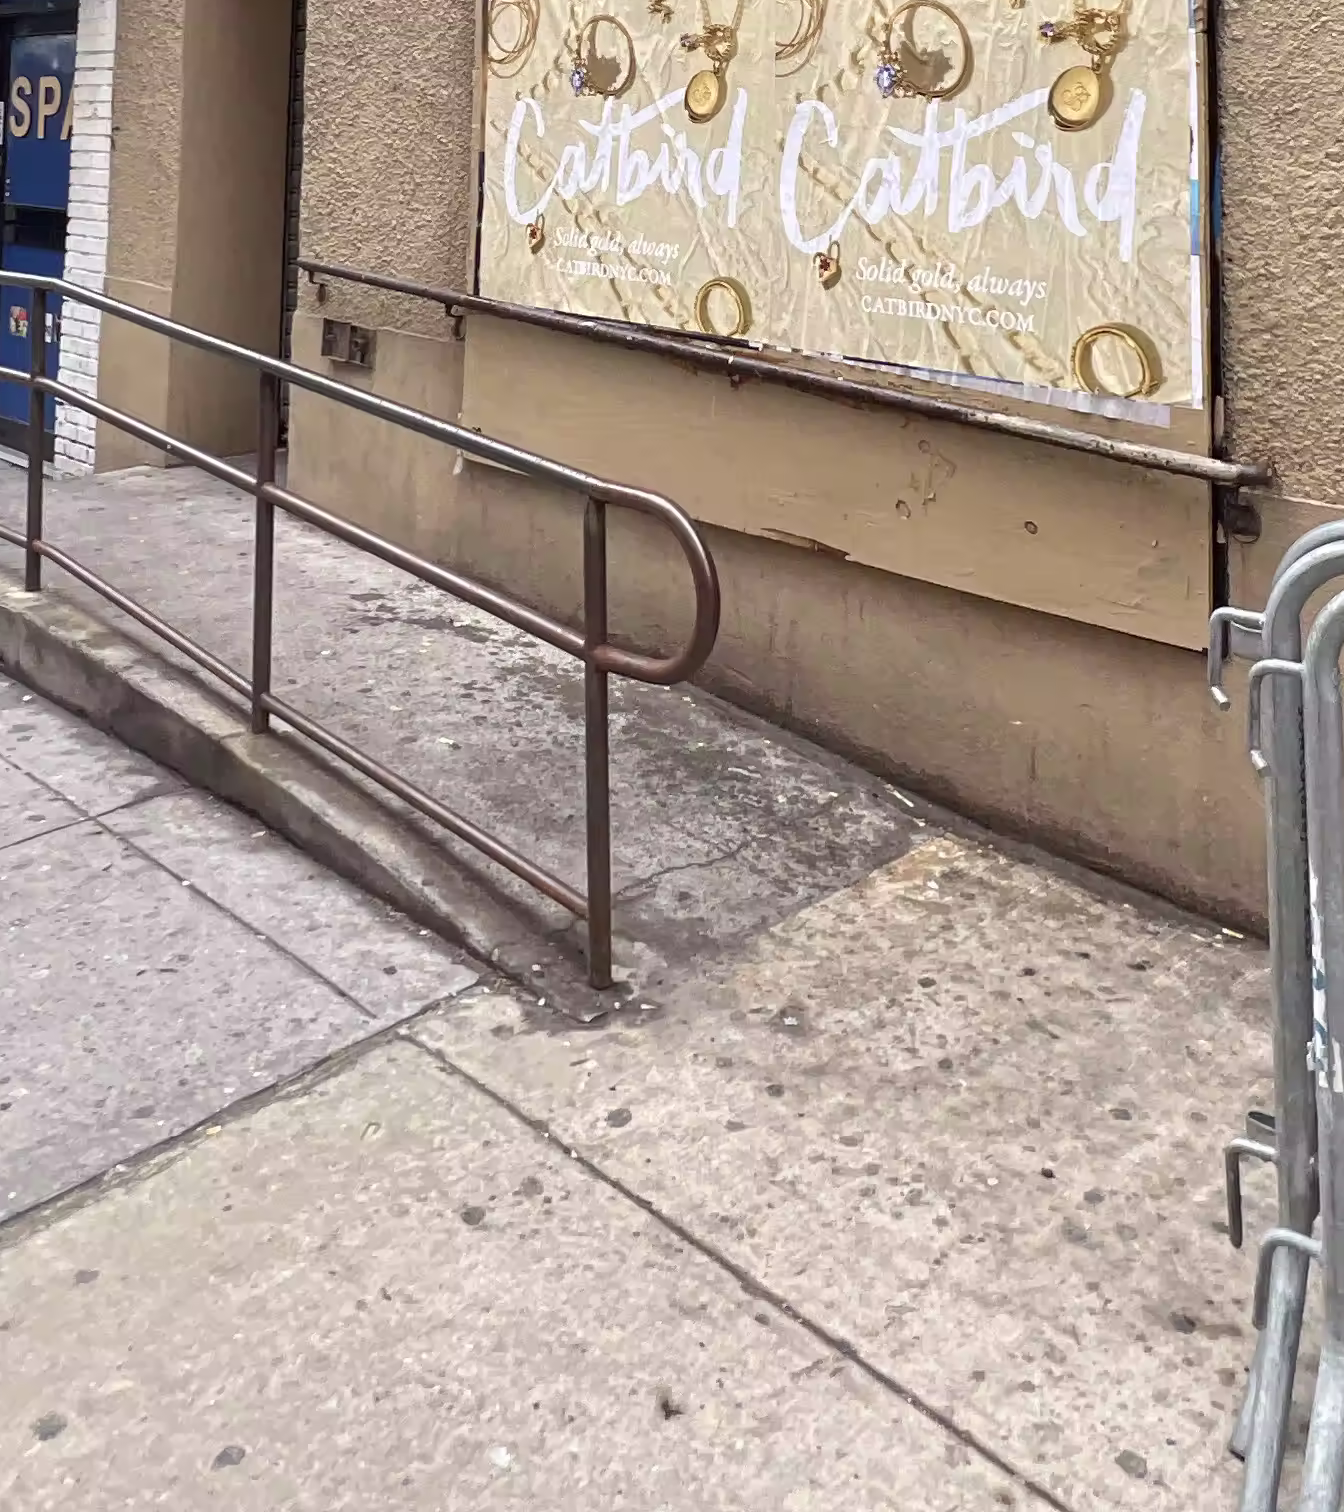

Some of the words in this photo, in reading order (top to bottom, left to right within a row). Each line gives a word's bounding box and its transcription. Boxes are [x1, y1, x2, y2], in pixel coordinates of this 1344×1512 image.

[503, 87, 747, 228] Catbird
[779, 88, 1147, 264] Catbird
[554, 227, 588, 249] Solid
[627, 233, 680, 265] always
[556, 257, 672, 286] CATBIRDNYC.COM
[855, 256, 907, 285] Solid
[908, 261, 962, 295] gold,
[965, 266, 1048, 307] always
[860, 295, 1036, 334] CATBIRDNYC.COM
